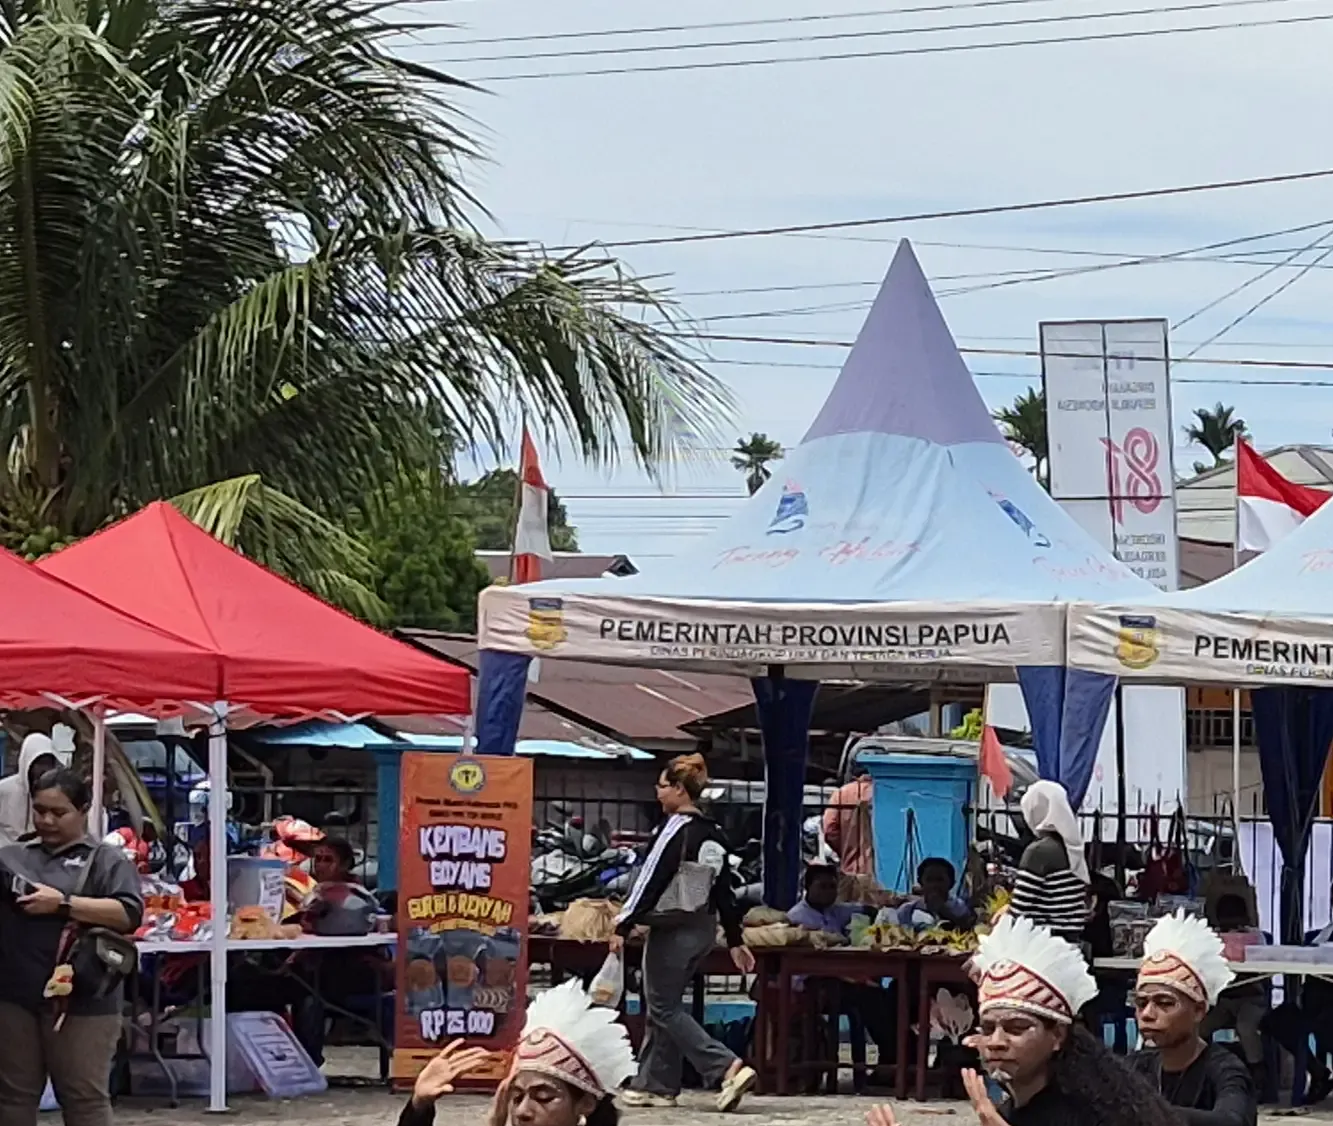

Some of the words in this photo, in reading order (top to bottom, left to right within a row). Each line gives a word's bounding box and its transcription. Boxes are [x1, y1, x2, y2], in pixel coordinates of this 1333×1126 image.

[599, 617, 773, 645] PEMERINTAH
[781, 623, 910, 647] PROVINSI
[918, 622, 1011, 646] PAPUA
[419, 824, 507, 859] KEMBANG
[420, 1009, 445, 1041] RP
